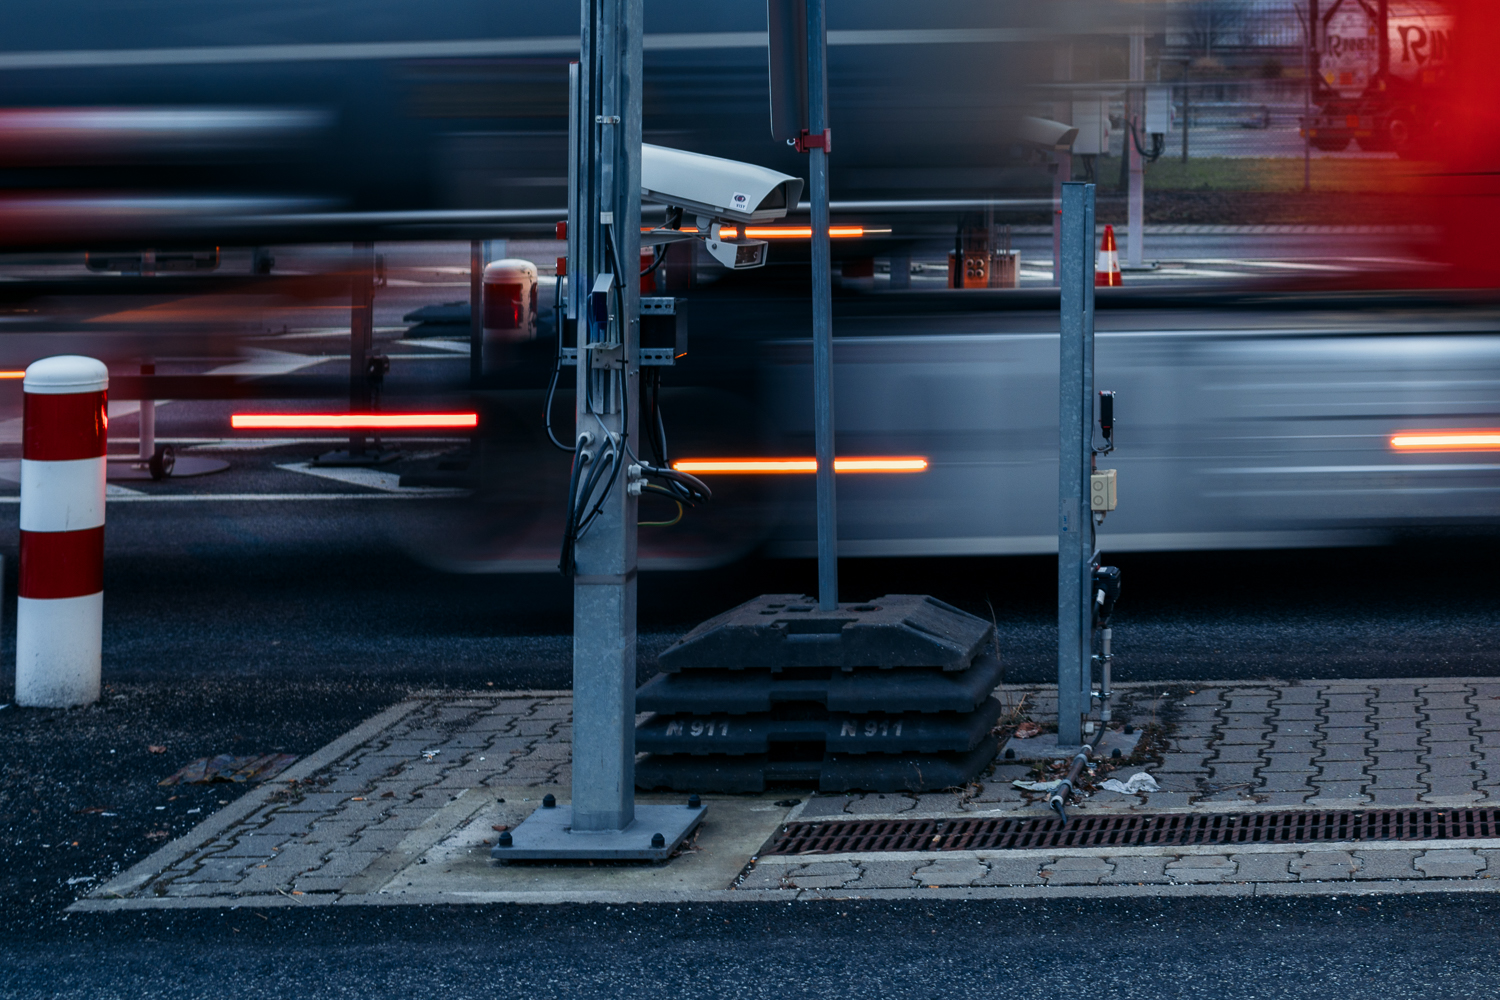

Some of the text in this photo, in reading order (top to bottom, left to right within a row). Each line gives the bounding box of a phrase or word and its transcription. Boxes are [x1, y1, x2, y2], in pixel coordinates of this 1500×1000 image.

[665, 721, 730, 737] N 911
[840, 720, 904, 737] N 911
